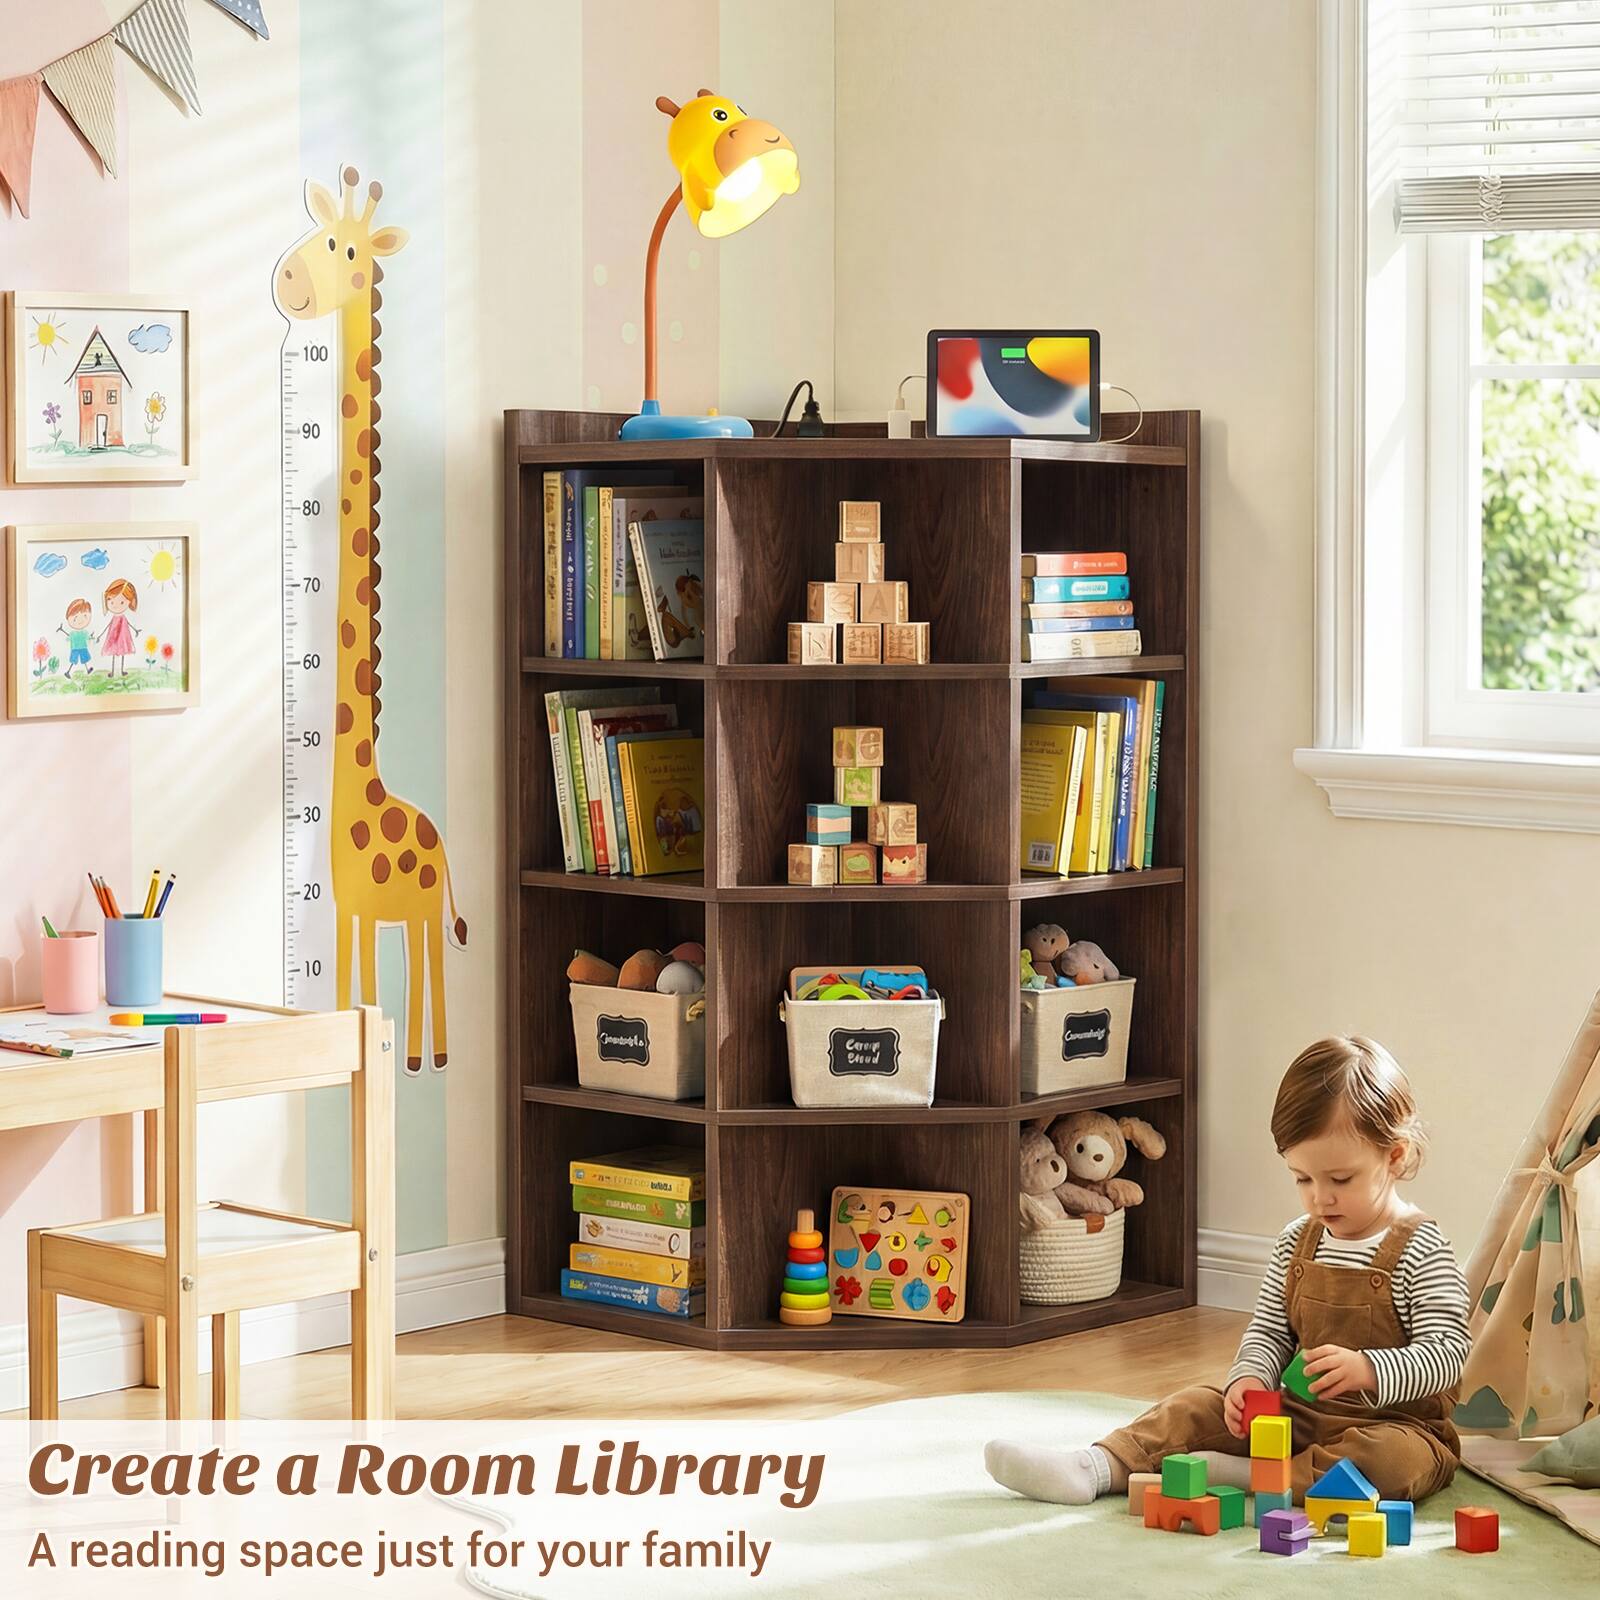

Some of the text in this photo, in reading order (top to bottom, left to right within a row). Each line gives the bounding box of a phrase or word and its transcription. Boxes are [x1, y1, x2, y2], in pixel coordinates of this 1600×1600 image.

[303, 345, 328, 362] 100
[302, 422, 321, 440] 90
[302, 499, 321, 517] 80
[303, 576, 321, 593] 70
[303, 653, 321, 670] 60
[302, 730, 321, 748] 50
[303, 805, 321, 824] 30
[303, 882, 321, 901] 20
[304, 959, 322, 978] 10
